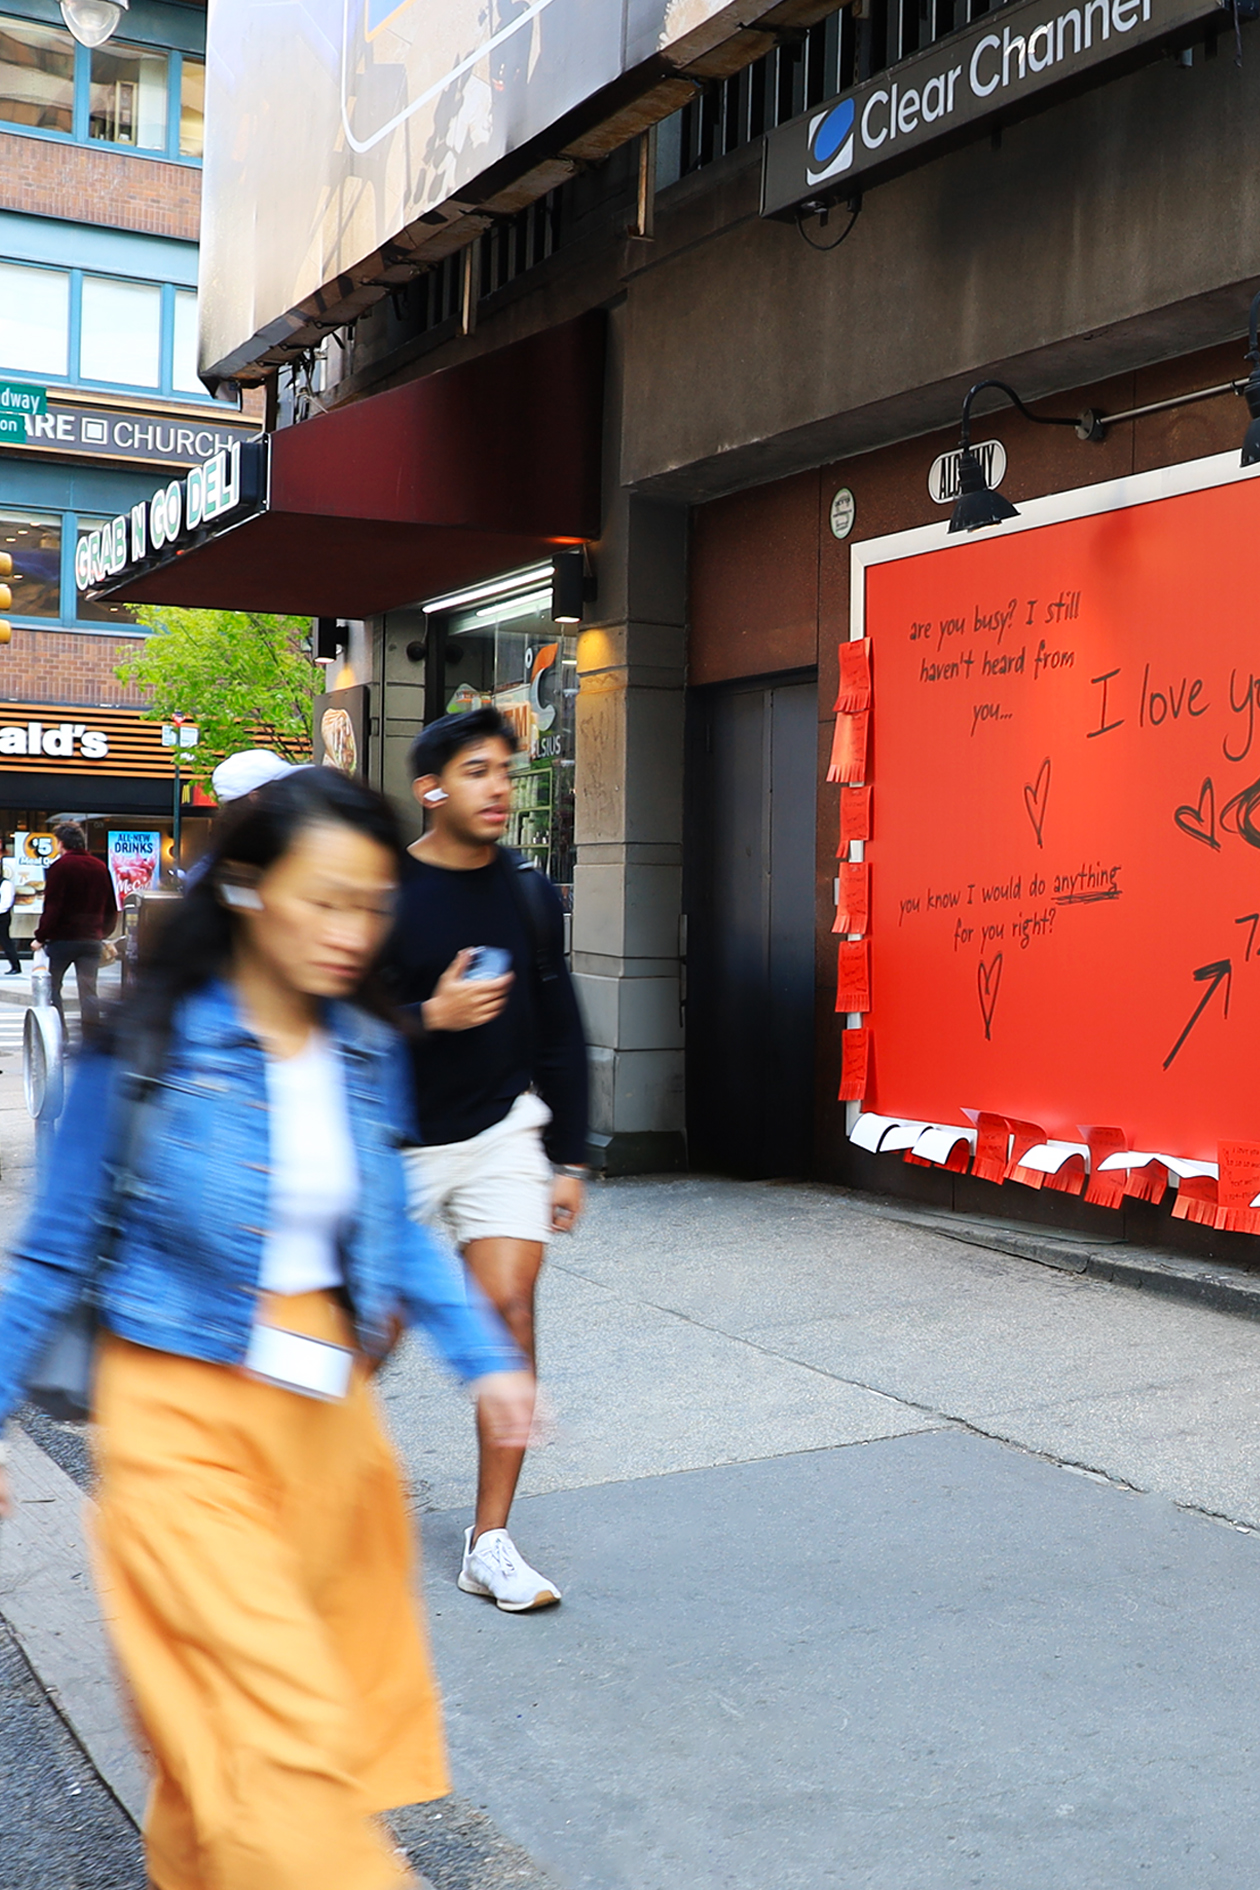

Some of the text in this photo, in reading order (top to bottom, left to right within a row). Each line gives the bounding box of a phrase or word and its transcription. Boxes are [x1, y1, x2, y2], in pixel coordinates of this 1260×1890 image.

[859, 64, 963, 151] Clear
[1, 387, 40, 415] dway
[113, 421, 233, 457] CHURCH
[75, 441, 241, 591] GRAB N GO DELI
[909, 590, 1081, 652] are you busy? I still
[919, 639, 1075, 683] haven't heard from
[970, 702, 1013, 738] you...
[1086, 668, 1126, 739] I
[1140, 663, 1211, 728] love
[0, 722, 109, 759] ald's
[114, 842, 153, 853] DRINKS
[118, 834, 151, 842] ALL-NEW
[898, 860, 1123, 928] you know I would do anything
[953, 907, 1056, 954] for you right?
